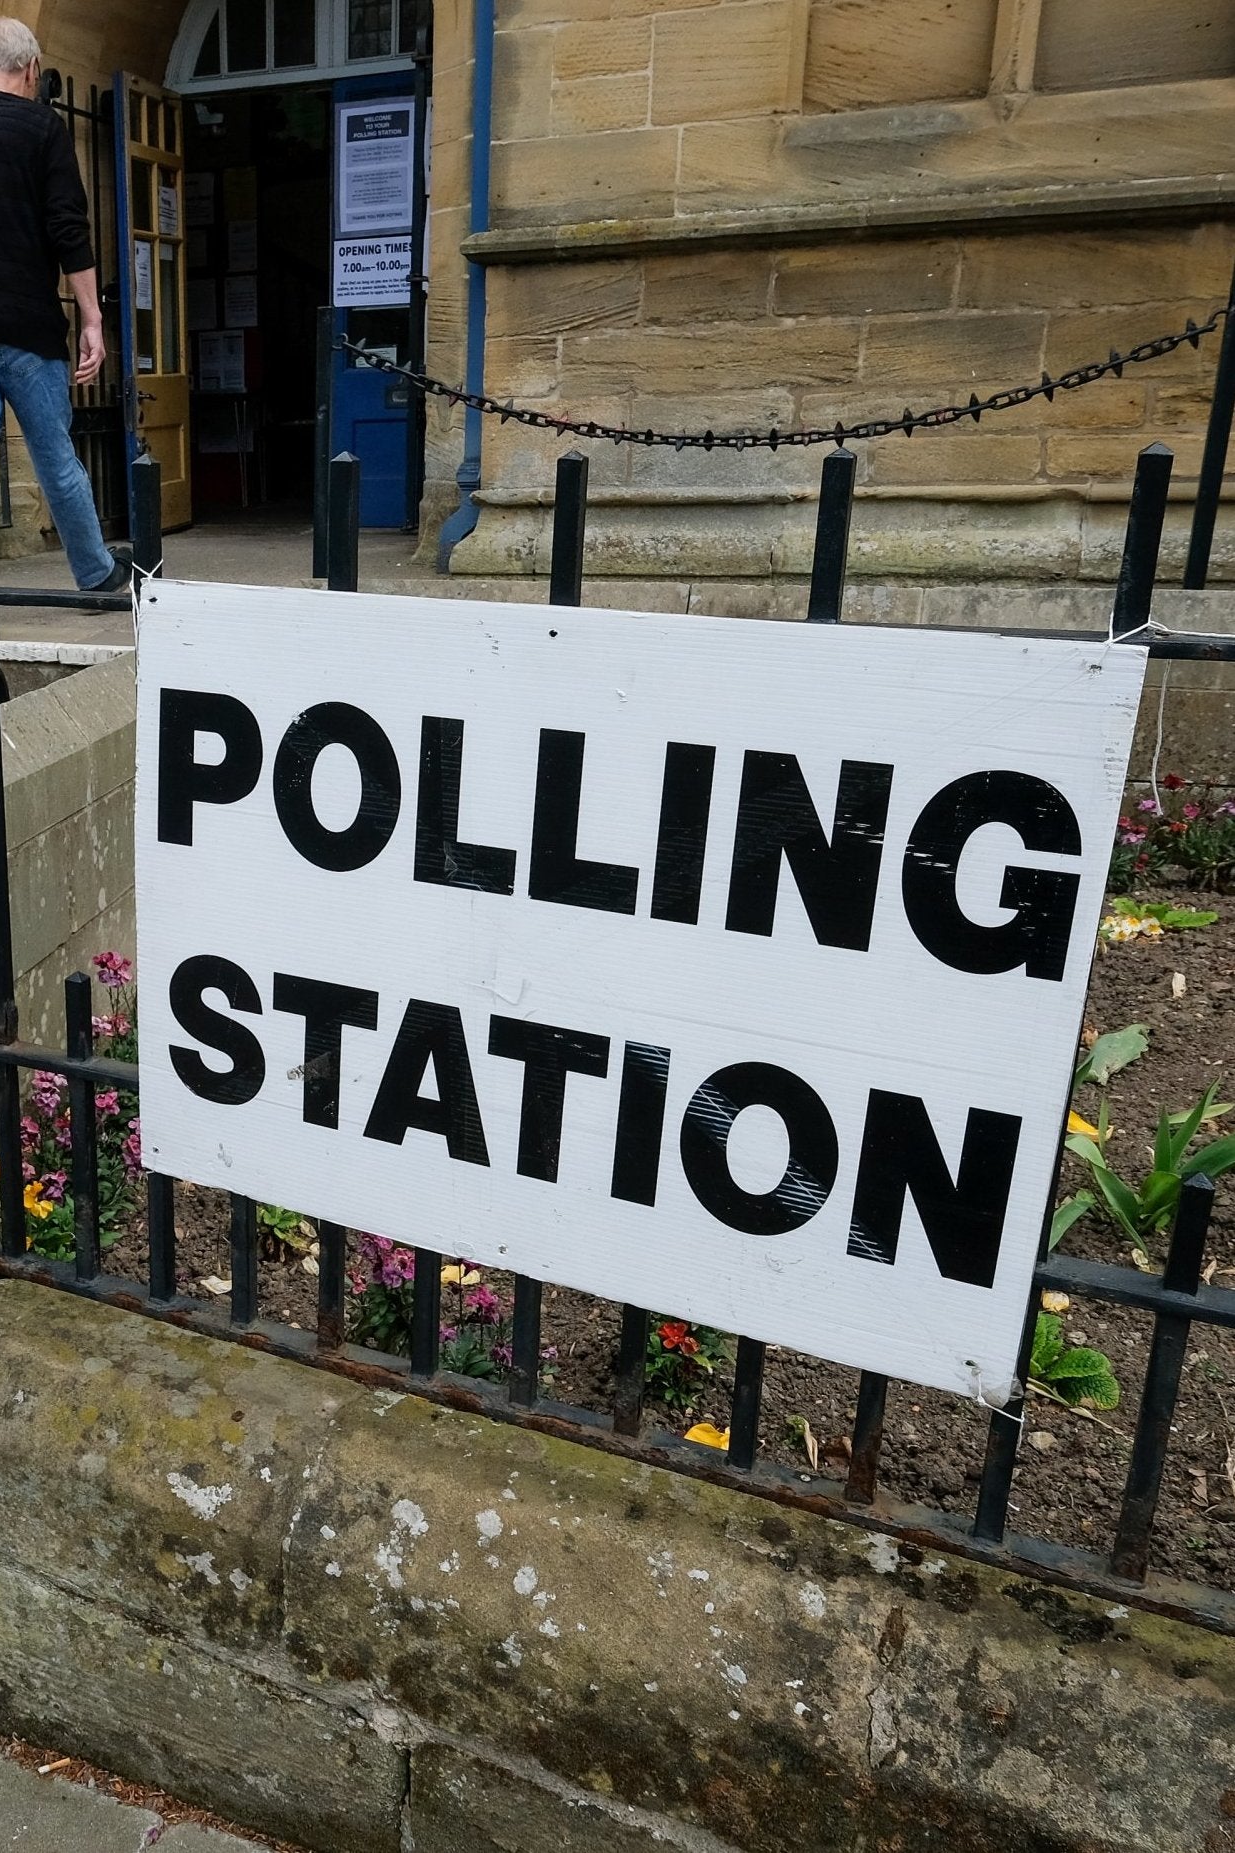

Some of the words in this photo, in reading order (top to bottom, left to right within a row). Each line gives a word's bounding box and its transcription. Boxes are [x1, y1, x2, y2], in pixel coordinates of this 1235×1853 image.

[364, 114, 392, 122] WELCOME
[353, 130, 377, 138] POLLING
[378, 128, 402, 136] STATION
[339, 244, 381, 257] OPENING
[157, 687, 1082, 982] POLLING
[169, 954, 1021, 1289] STATION
